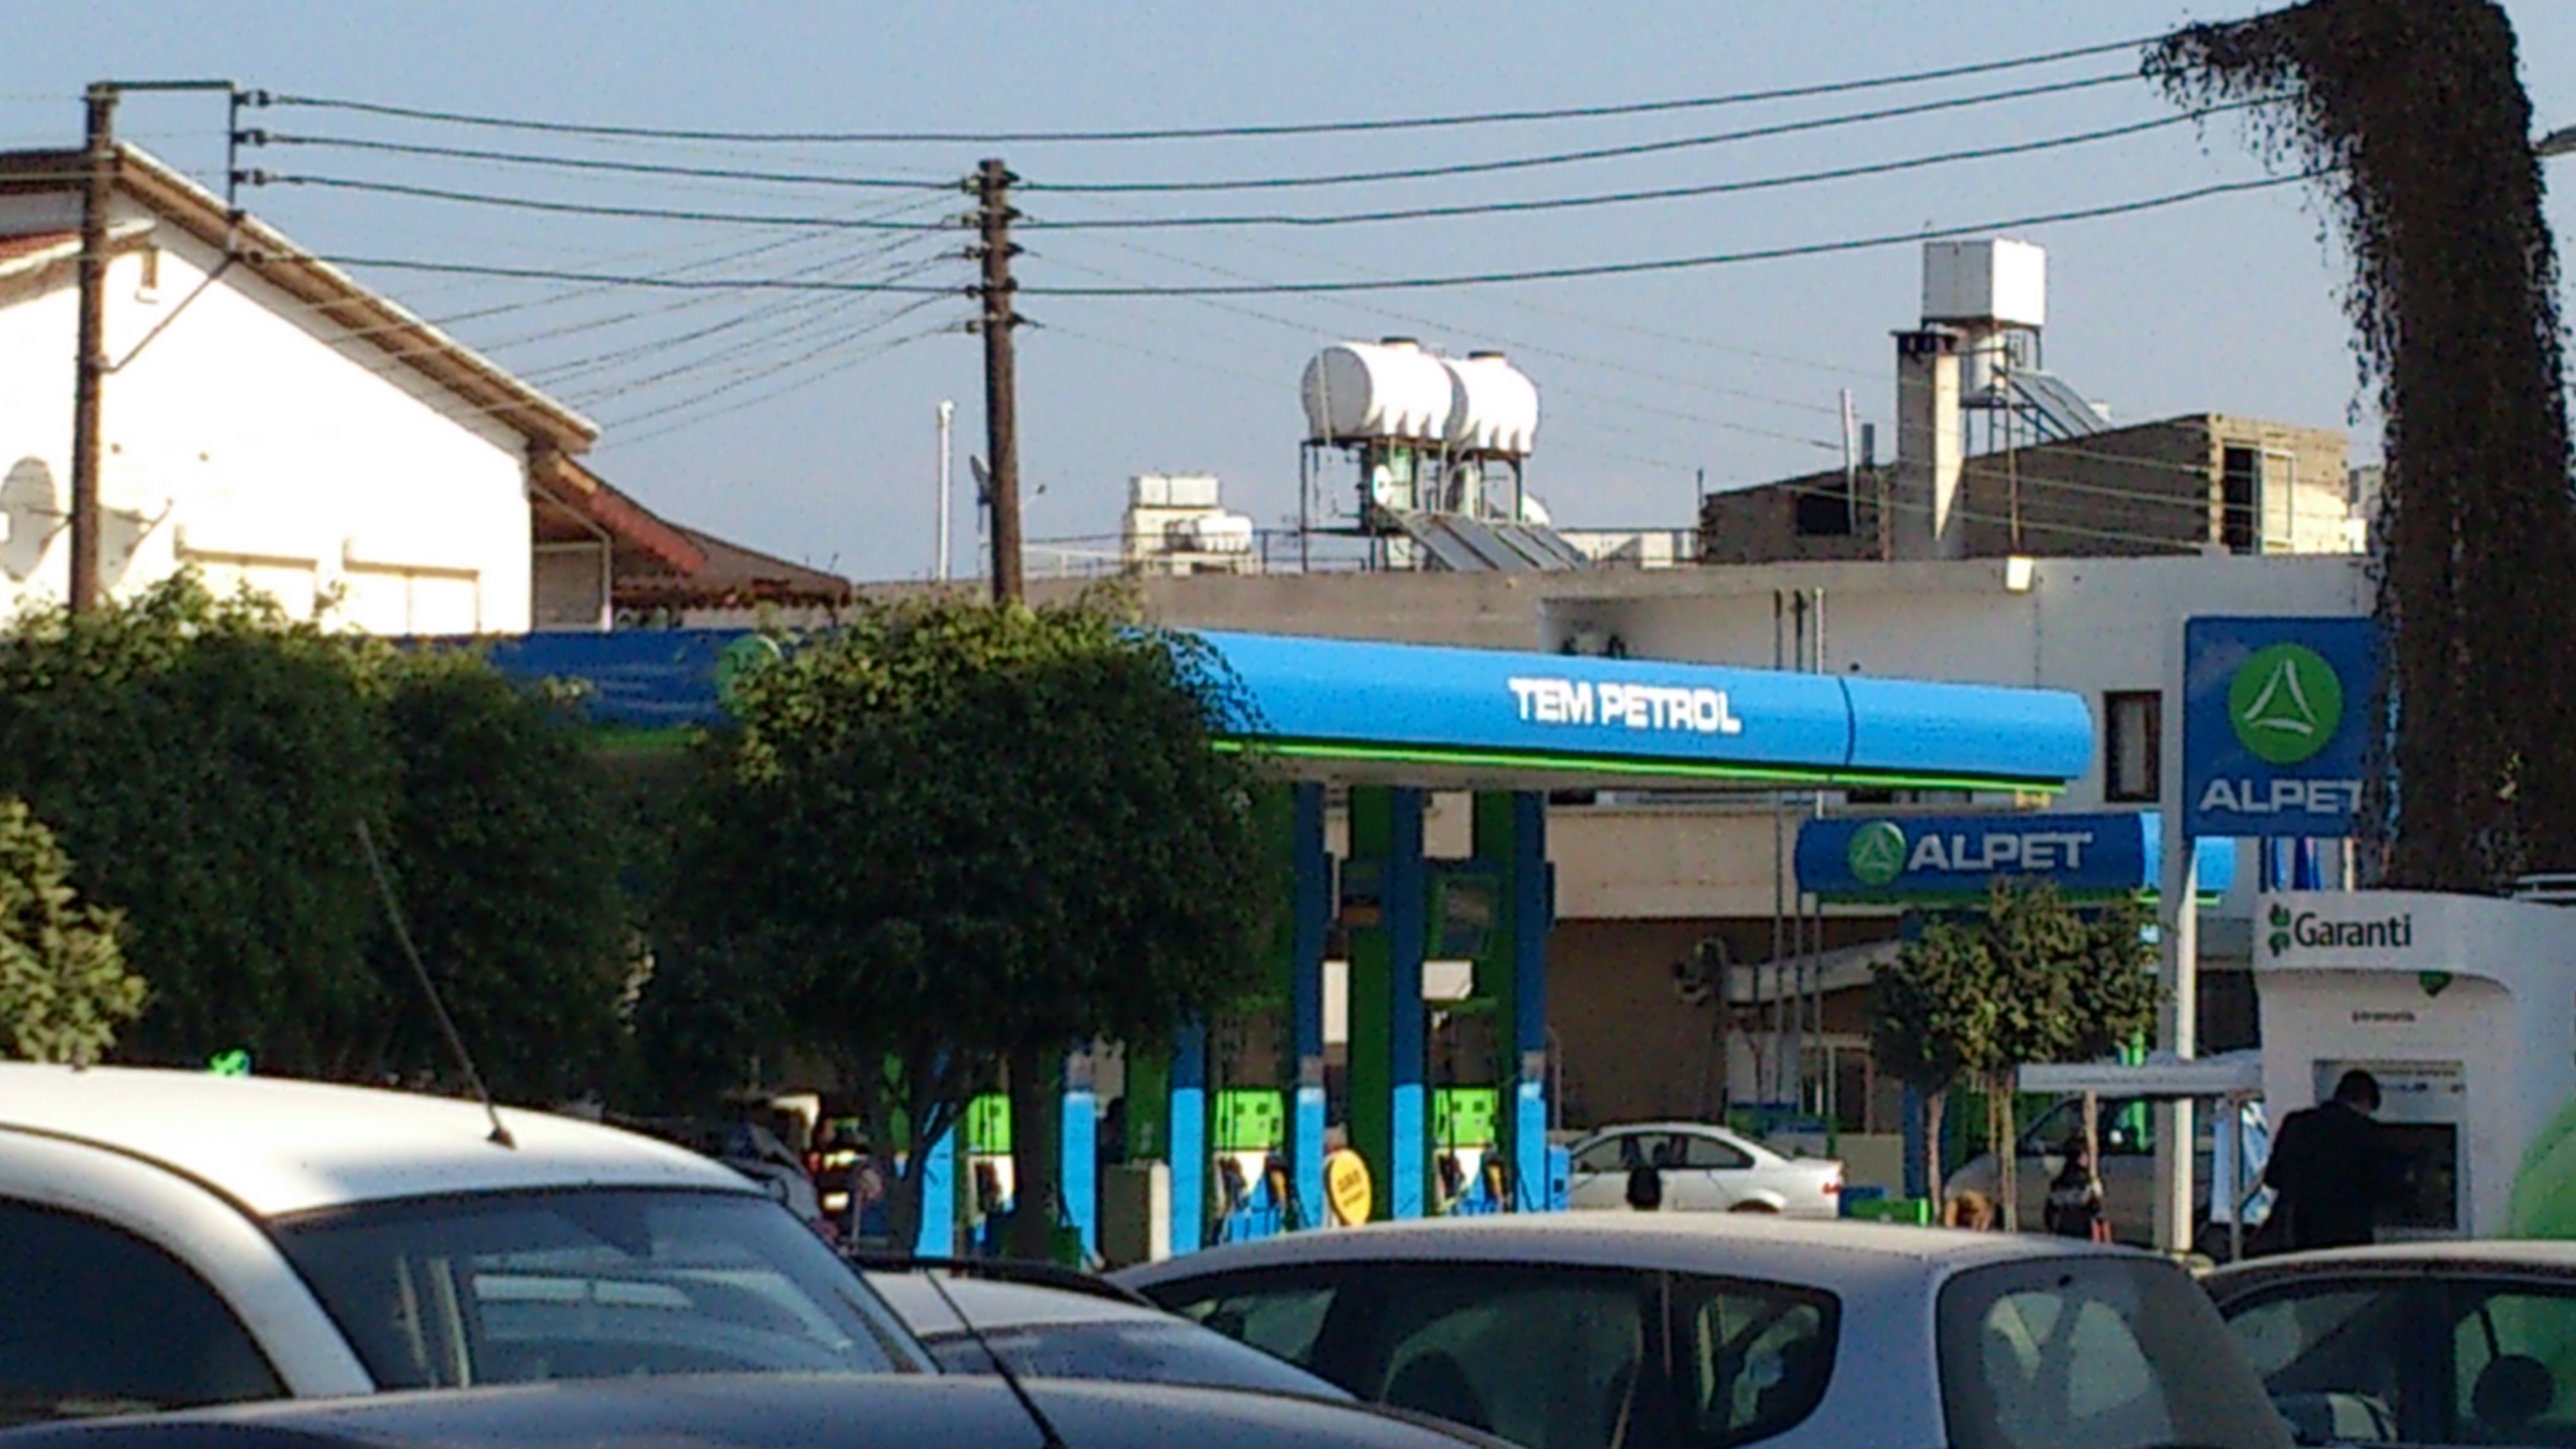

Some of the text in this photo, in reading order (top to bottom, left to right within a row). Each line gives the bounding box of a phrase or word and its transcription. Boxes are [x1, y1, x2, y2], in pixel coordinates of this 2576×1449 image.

[1508, 677, 1741, 733] TEM PETROL
[2199, 779, 2362, 812] ALPET
[1908, 833, 2093, 869] ALPET
[2295, 913, 2411, 947] Garanti
